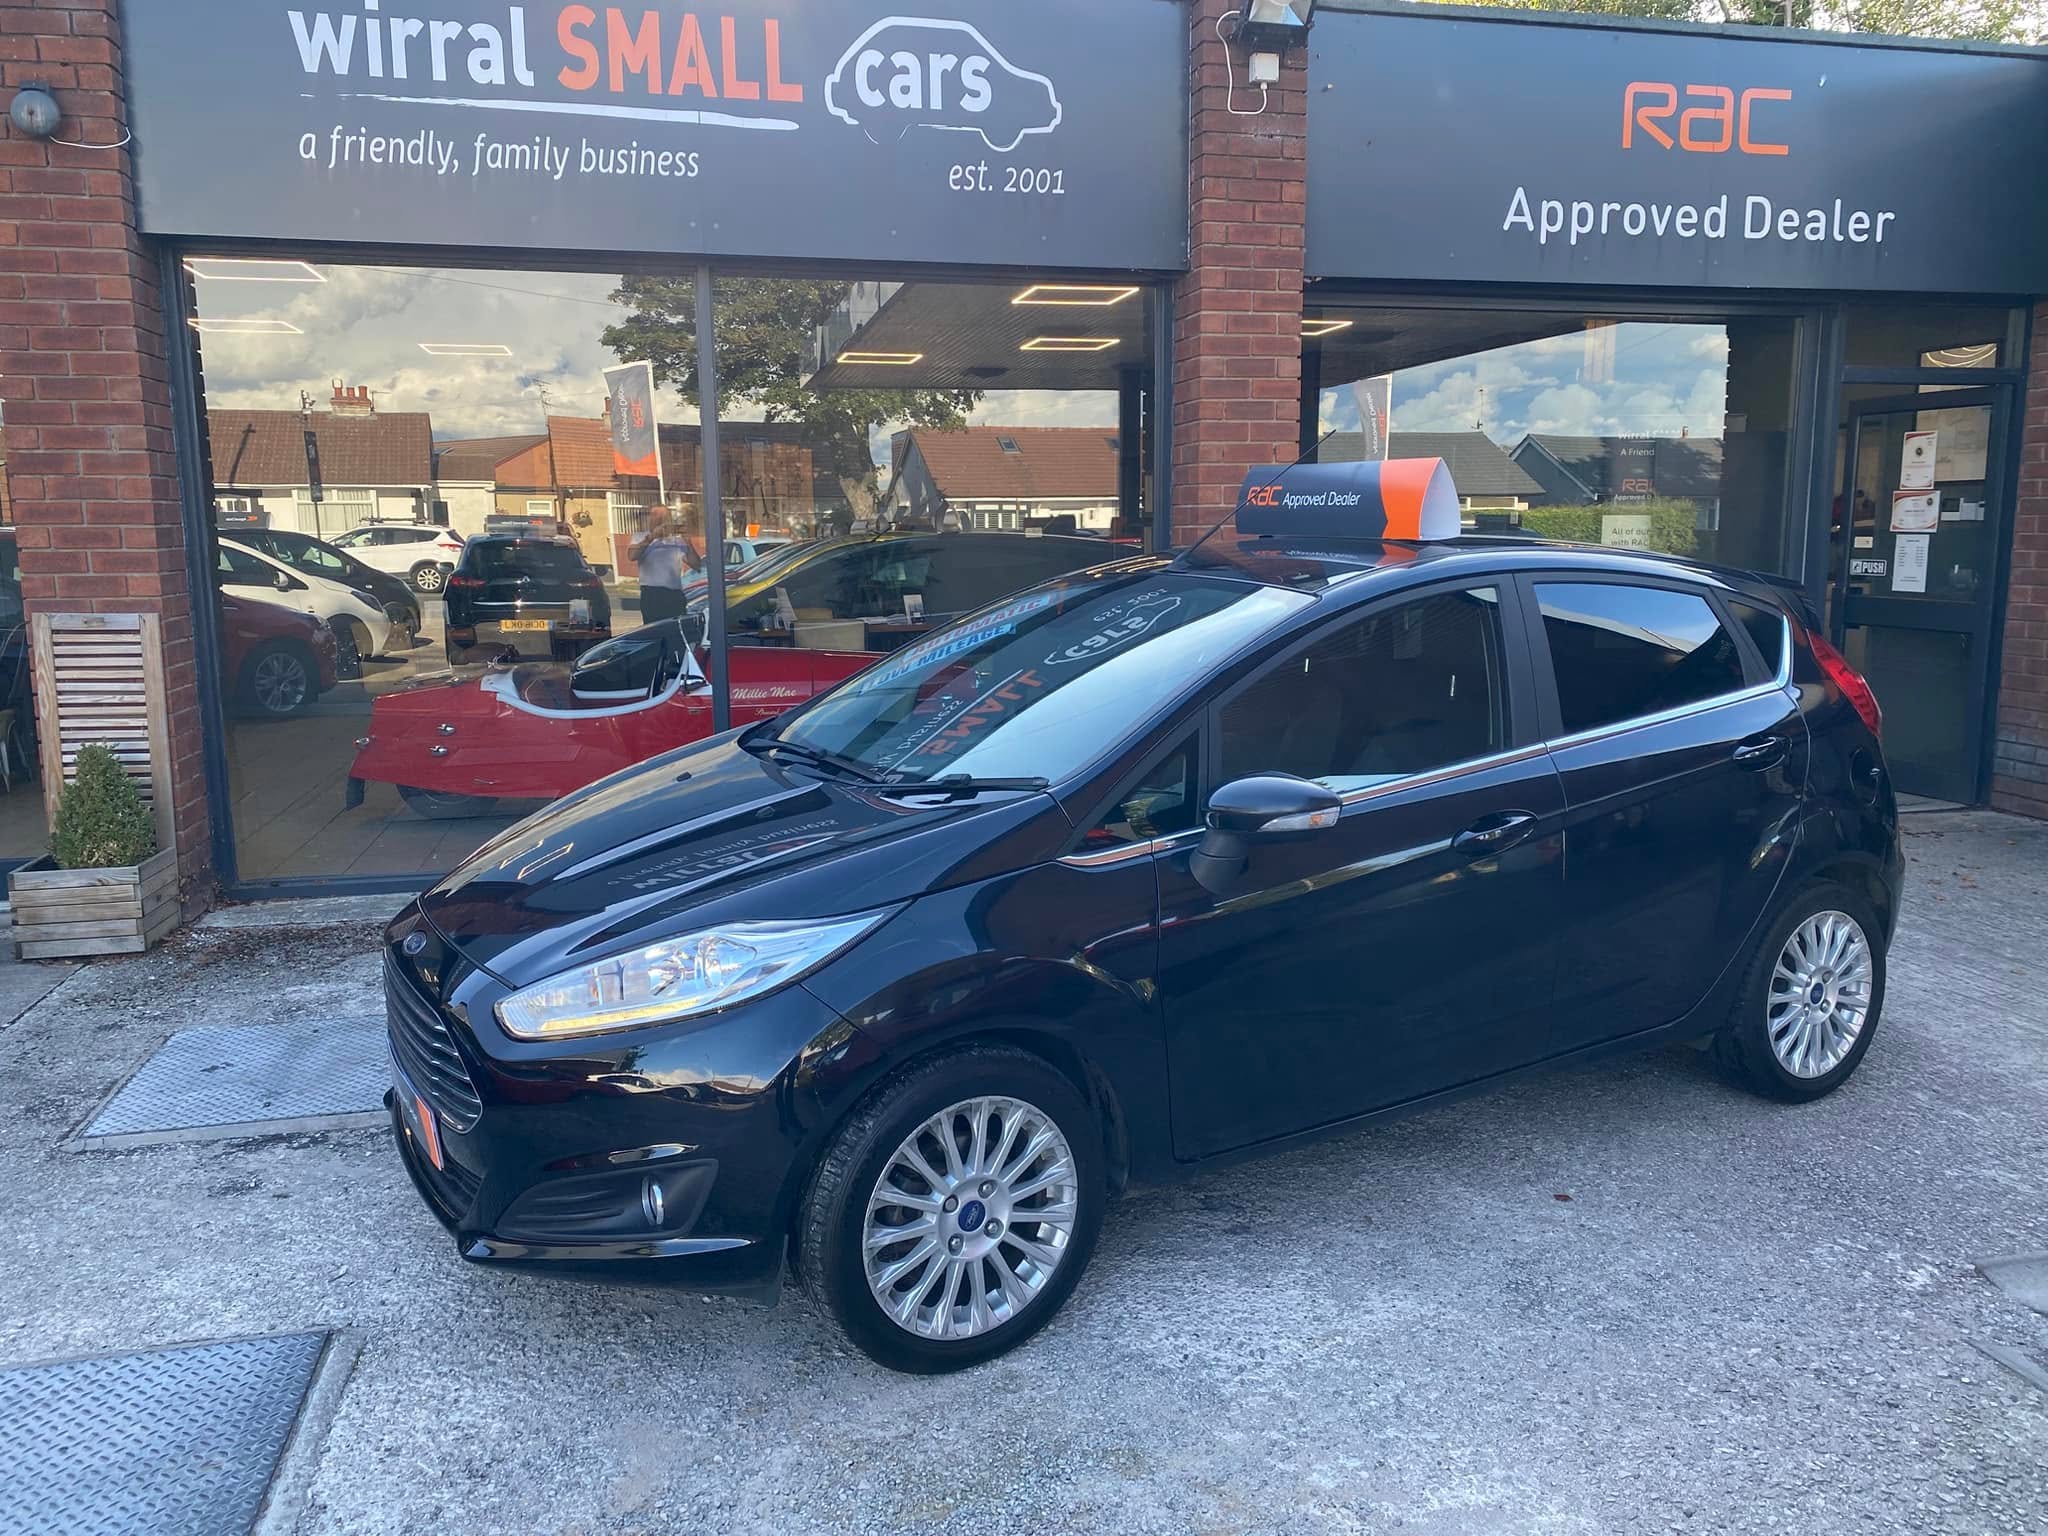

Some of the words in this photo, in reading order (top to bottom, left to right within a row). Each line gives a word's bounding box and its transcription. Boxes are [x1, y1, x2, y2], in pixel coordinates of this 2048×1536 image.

[287, 0, 535, 87] wirral
[556, 4, 804, 103] SMALL
[854, 49, 993, 112] cars
[299, 131, 317, 160] a
[328, 125, 460, 176] friendly,
[471, 132, 570, 181] family
[579, 138, 700, 178] business
[949, 159, 994, 192] est.
[1003, 167, 1065, 194] 2001
[1502, 186, 1728, 246] Approved
[1743, 195, 1896, 243] Dealer
[1282, 491, 1327, 510] Approved
[1327, 490, 1361, 506] Dealer
[1861, 561, 1884, 574] PUSH
[918, 624, 1007, 666] MILEAGE
